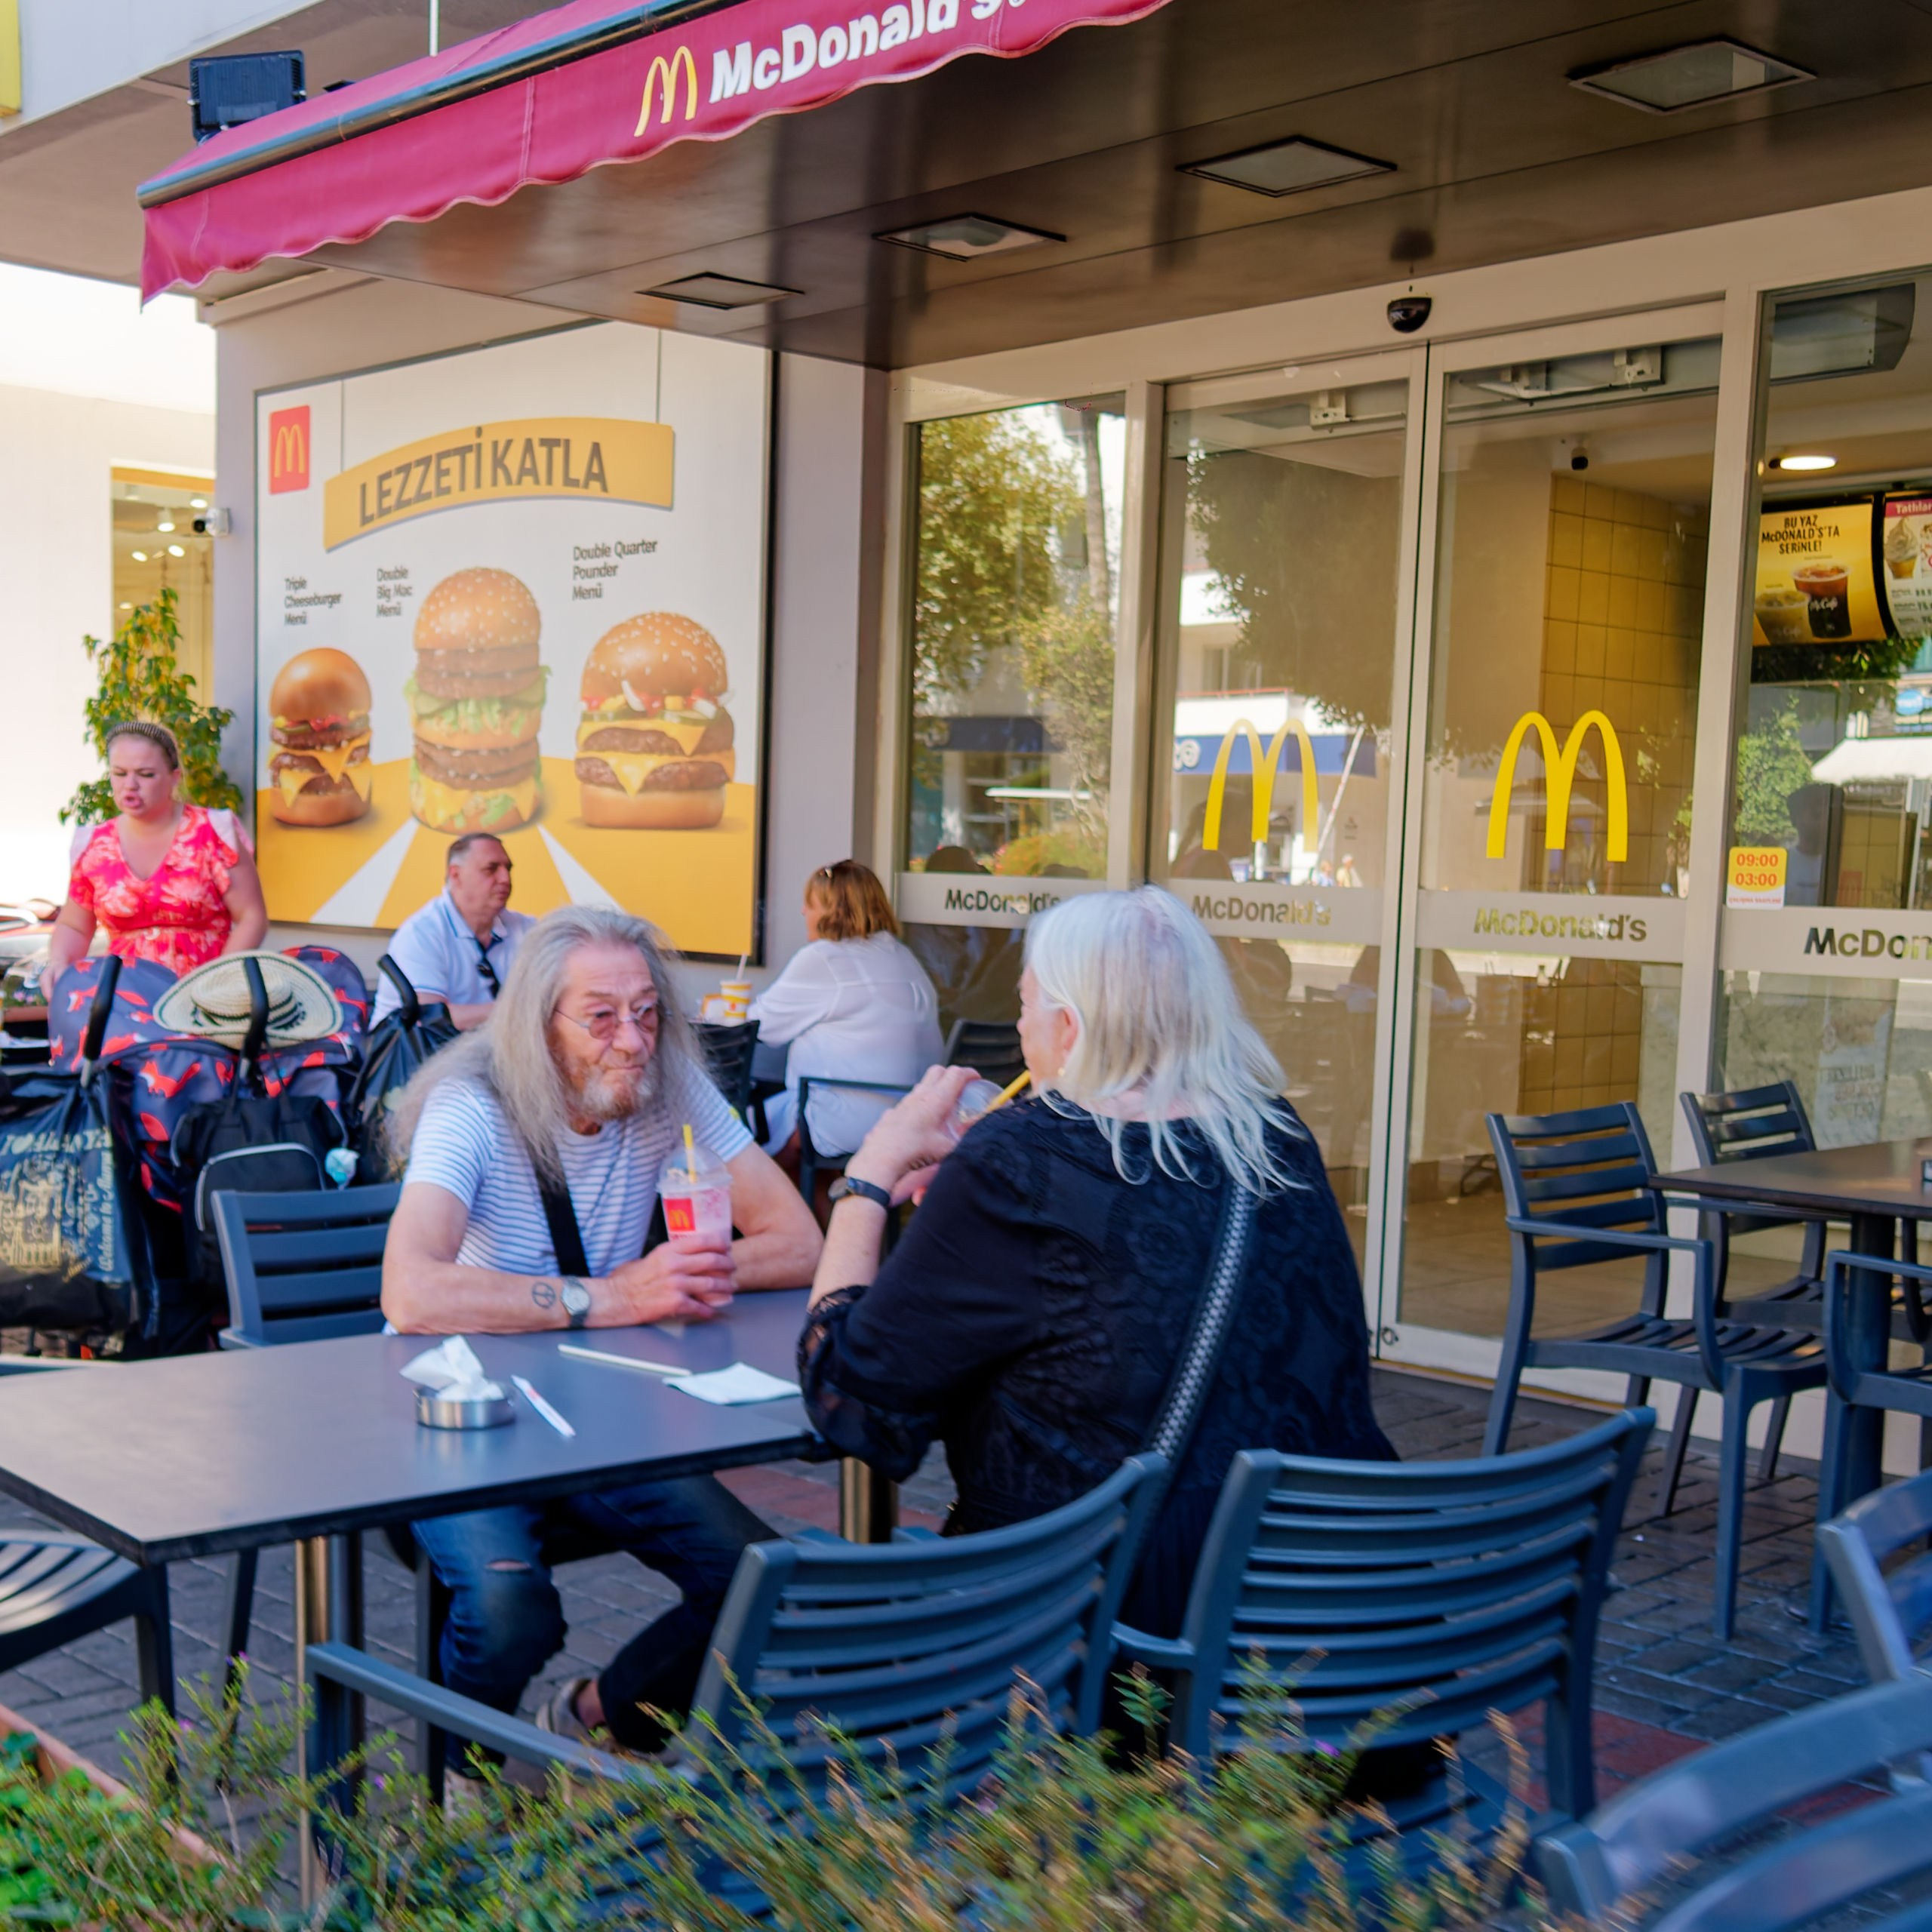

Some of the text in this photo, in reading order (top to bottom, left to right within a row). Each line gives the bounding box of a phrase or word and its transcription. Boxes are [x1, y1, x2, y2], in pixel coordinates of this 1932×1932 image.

[359, 426, 608, 527] LEZZETİ KATLA
[1784, 515, 1818, 528] BU YAZ
[574, 540, 658, 561] Double Quarter
[377, 566, 408, 582] Double
[573, 562, 619, 580] Pounder
[572, 583, 603, 601] Menü
[1737, 854, 1779, 867] 09:00
[1736, 872, 1777, 887] 03:00
[1192, 895, 1332, 926] McDonald's
[1474, 908, 1647, 943] McDonald's
